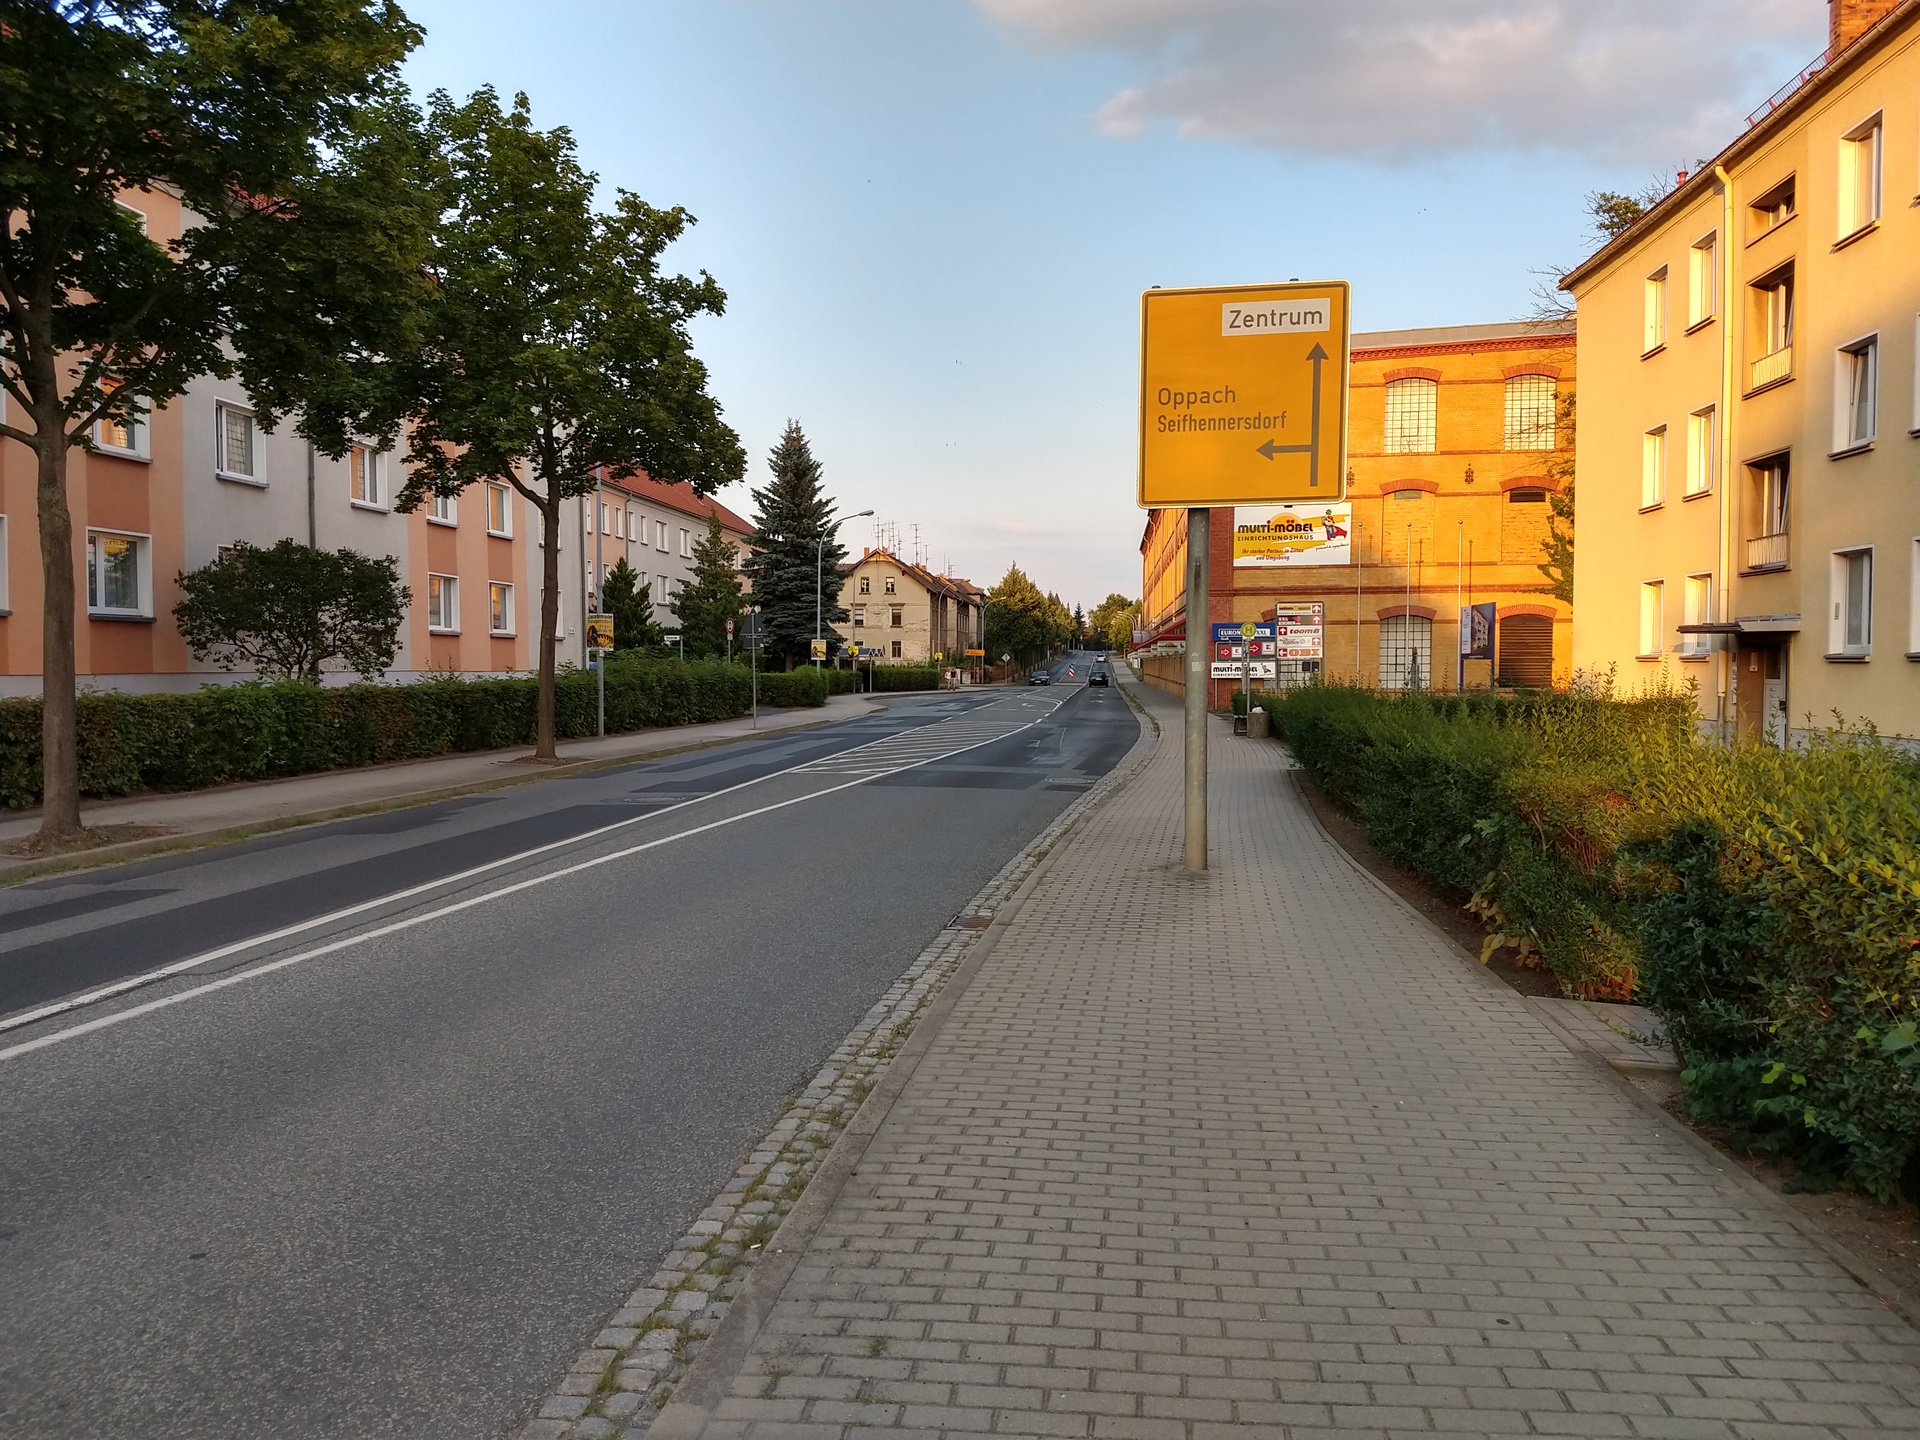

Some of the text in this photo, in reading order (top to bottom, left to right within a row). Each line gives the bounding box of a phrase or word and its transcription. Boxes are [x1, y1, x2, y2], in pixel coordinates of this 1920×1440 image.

[1229, 309, 1323, 329] Zentrum
[1158, 385, 1236, 410] Oppach
[1157, 411, 1287, 433] Seifhennersdorf
[1245, 626, 1252, 634] H
[1213, 664, 1258, 673] MULTI-MEL
